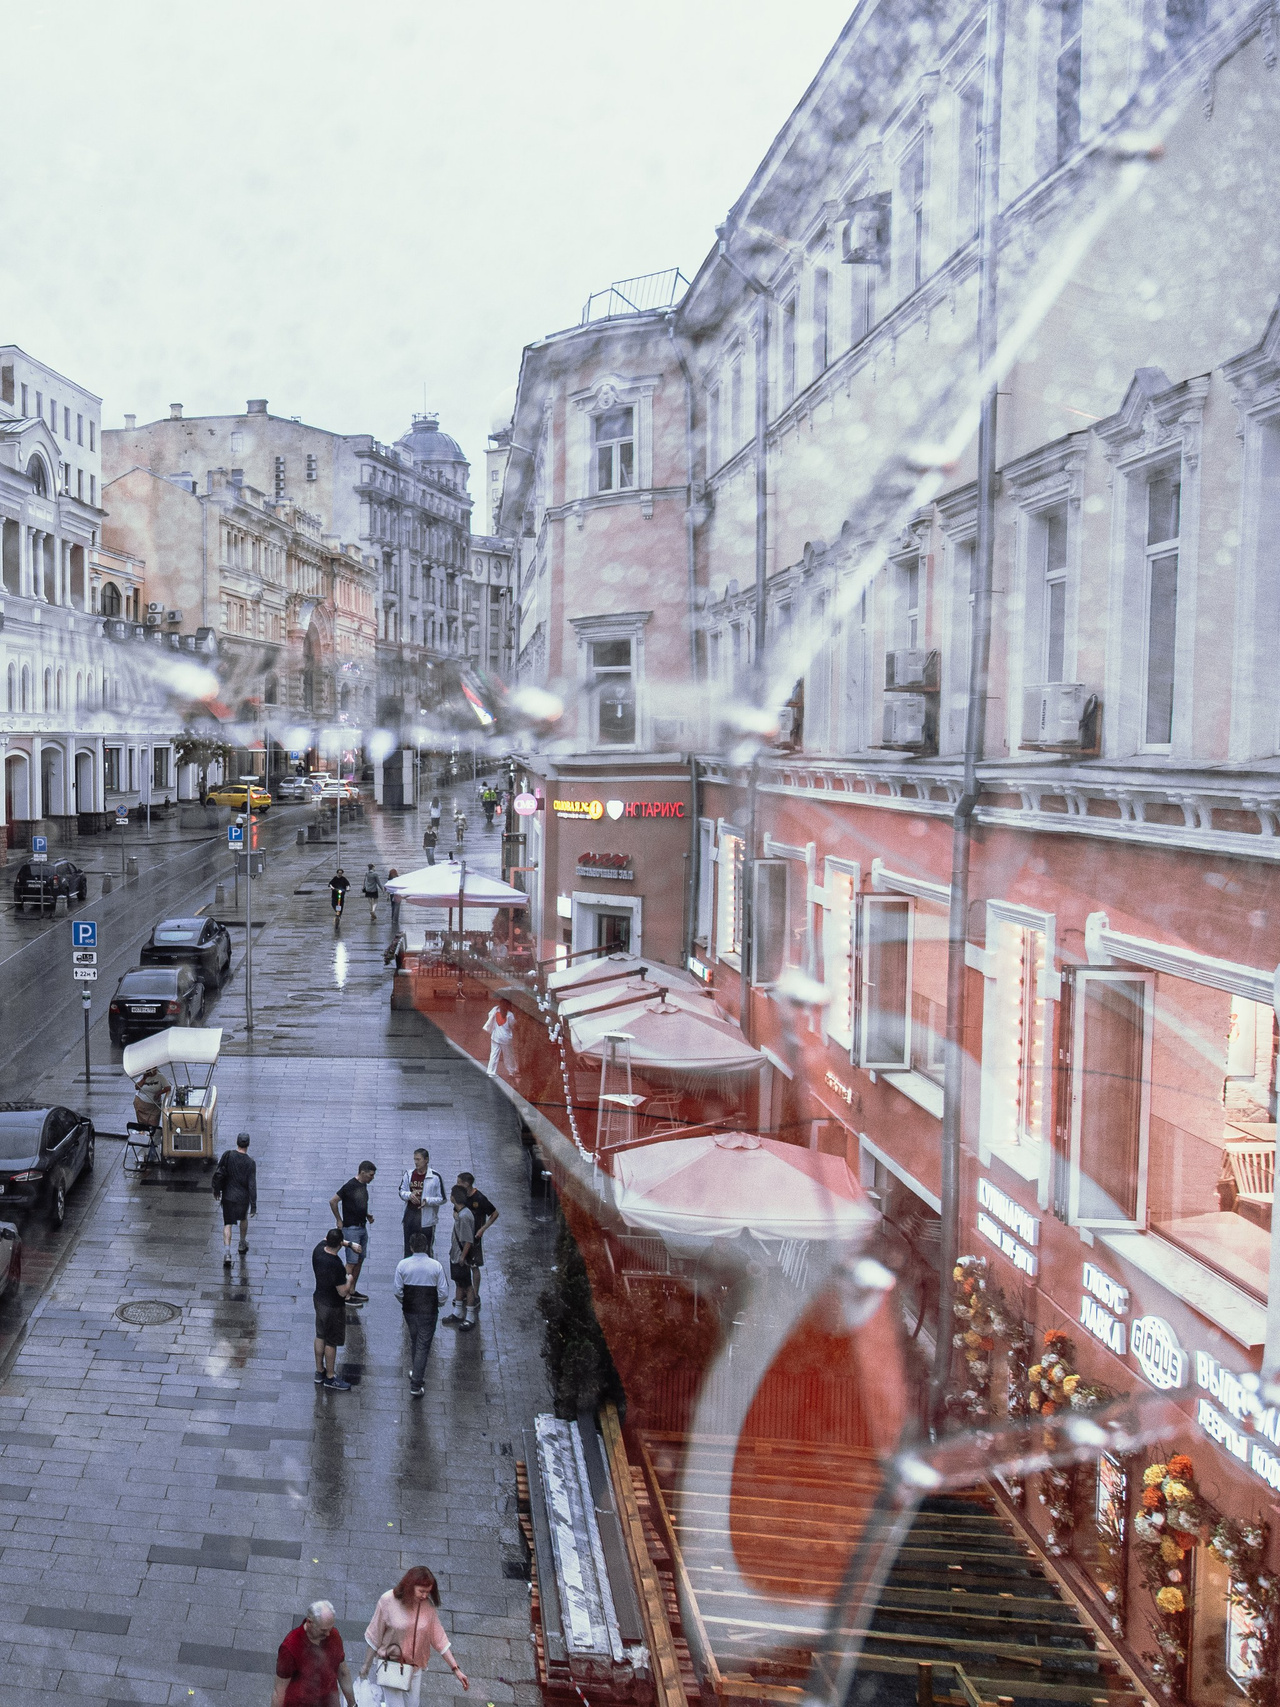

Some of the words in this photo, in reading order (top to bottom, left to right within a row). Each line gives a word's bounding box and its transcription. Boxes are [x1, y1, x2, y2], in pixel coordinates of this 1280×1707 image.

[625, 801, 685, 818] НОТАРИУС
[36, 838, 45, 850] P
[232, 827, 241, 840] P
[79, 924, 93, 944] P
[978, 1177, 1038, 1247] КУЛИНАРИЯ
[1082, 1261, 1127, 1315] ГЛОБУС
[1080, 1295, 1125, 1355] ЛАВКА
[1251, 1444, 1280, 1494] КОФ
